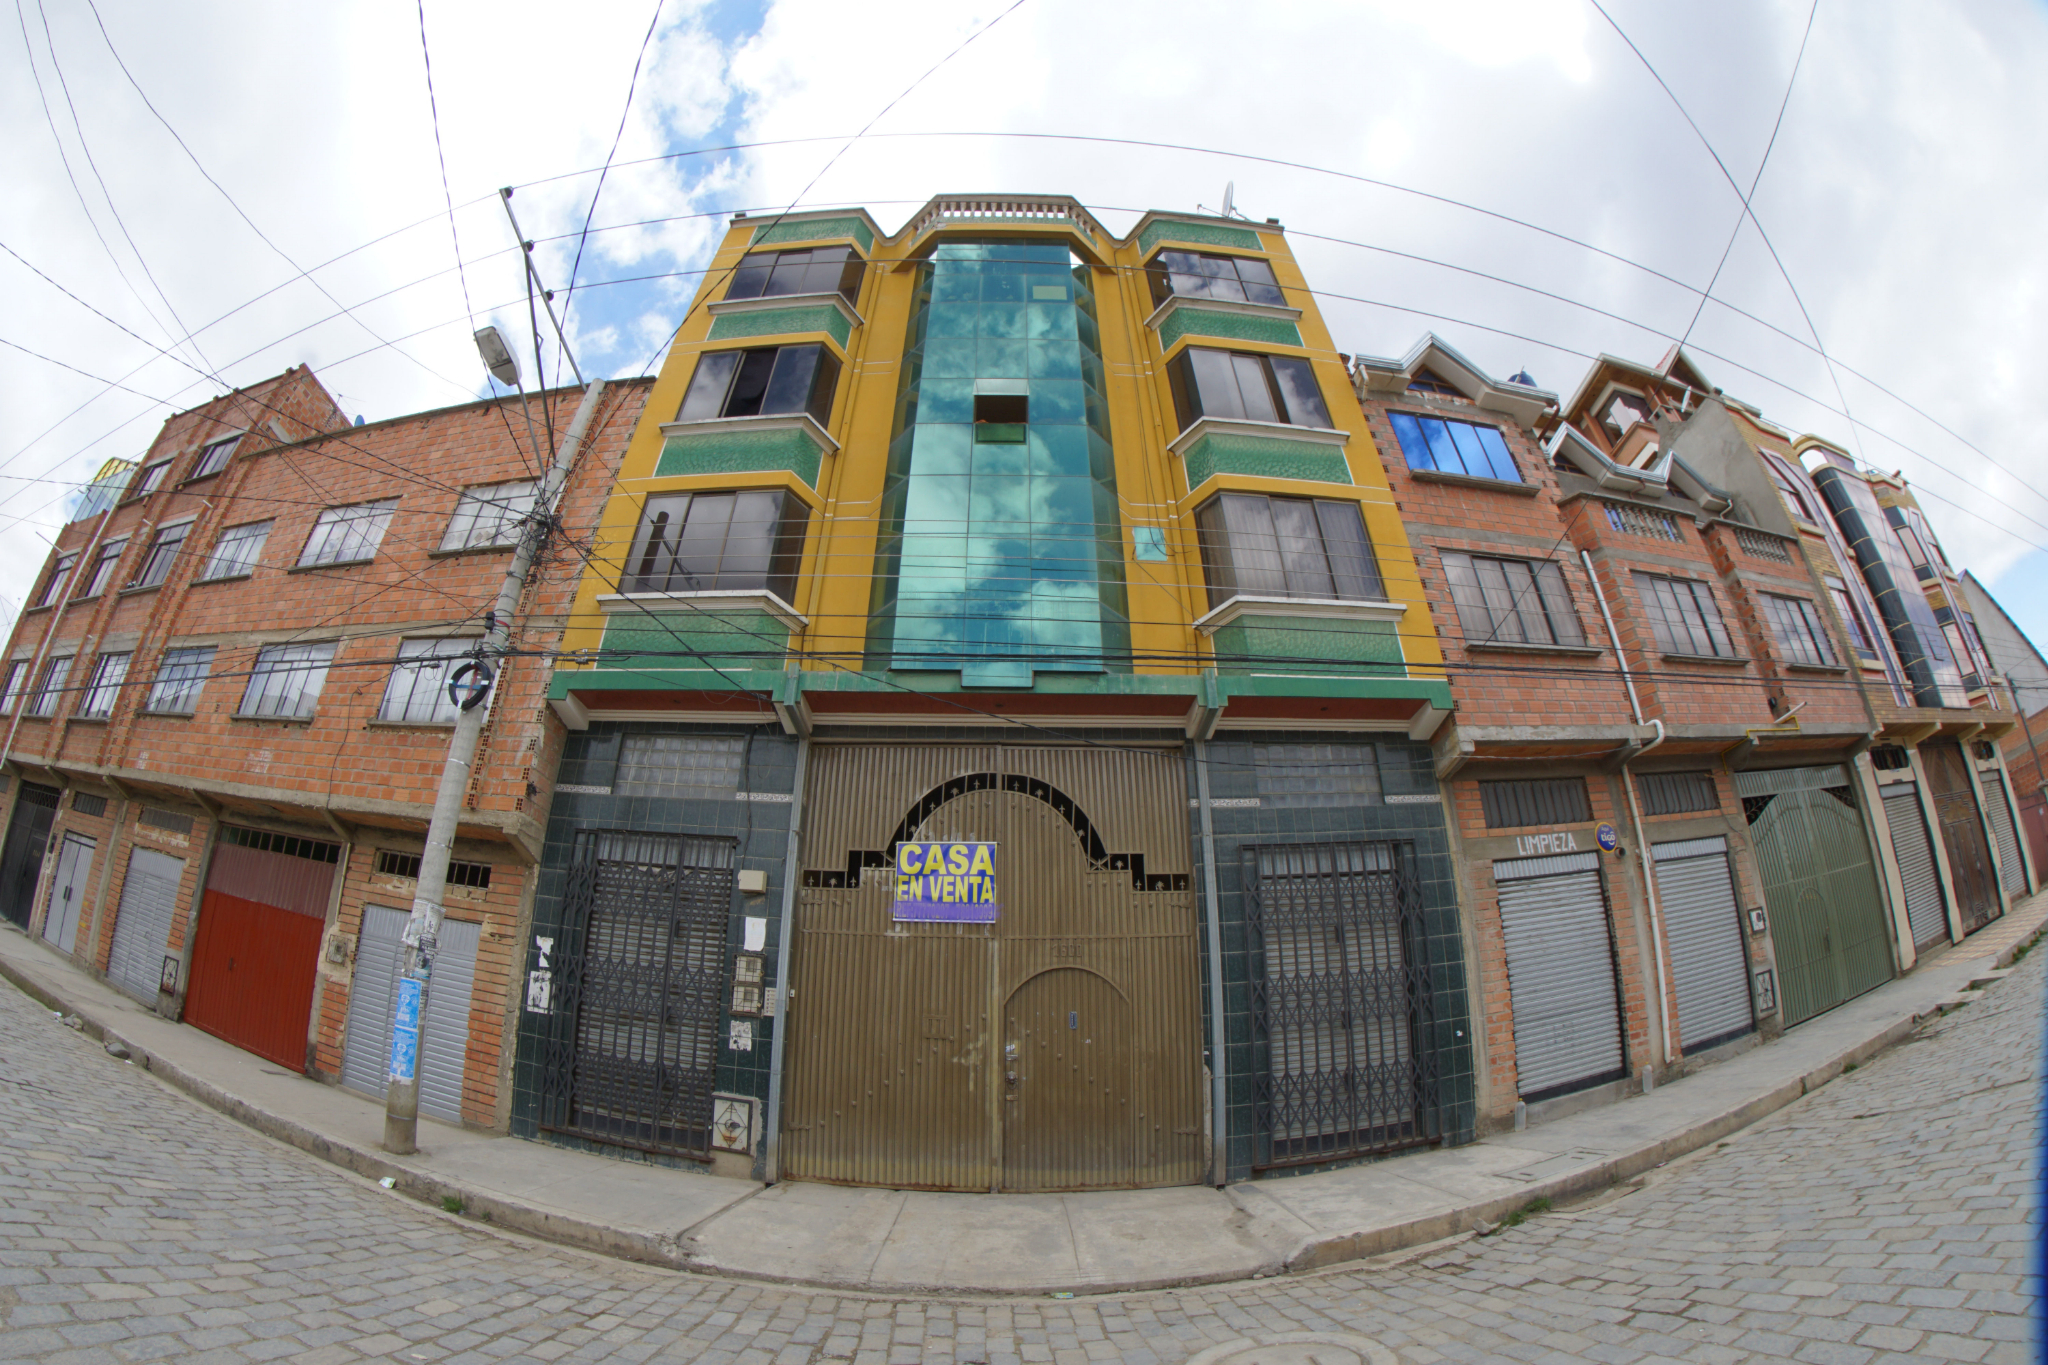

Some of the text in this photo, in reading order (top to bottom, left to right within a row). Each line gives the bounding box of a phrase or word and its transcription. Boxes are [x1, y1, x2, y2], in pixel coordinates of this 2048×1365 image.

[1516, 832, 1577, 856] LIMPIEZA
[899, 844, 994, 875] CASA
[897, 875, 994, 903] EN VENTA
